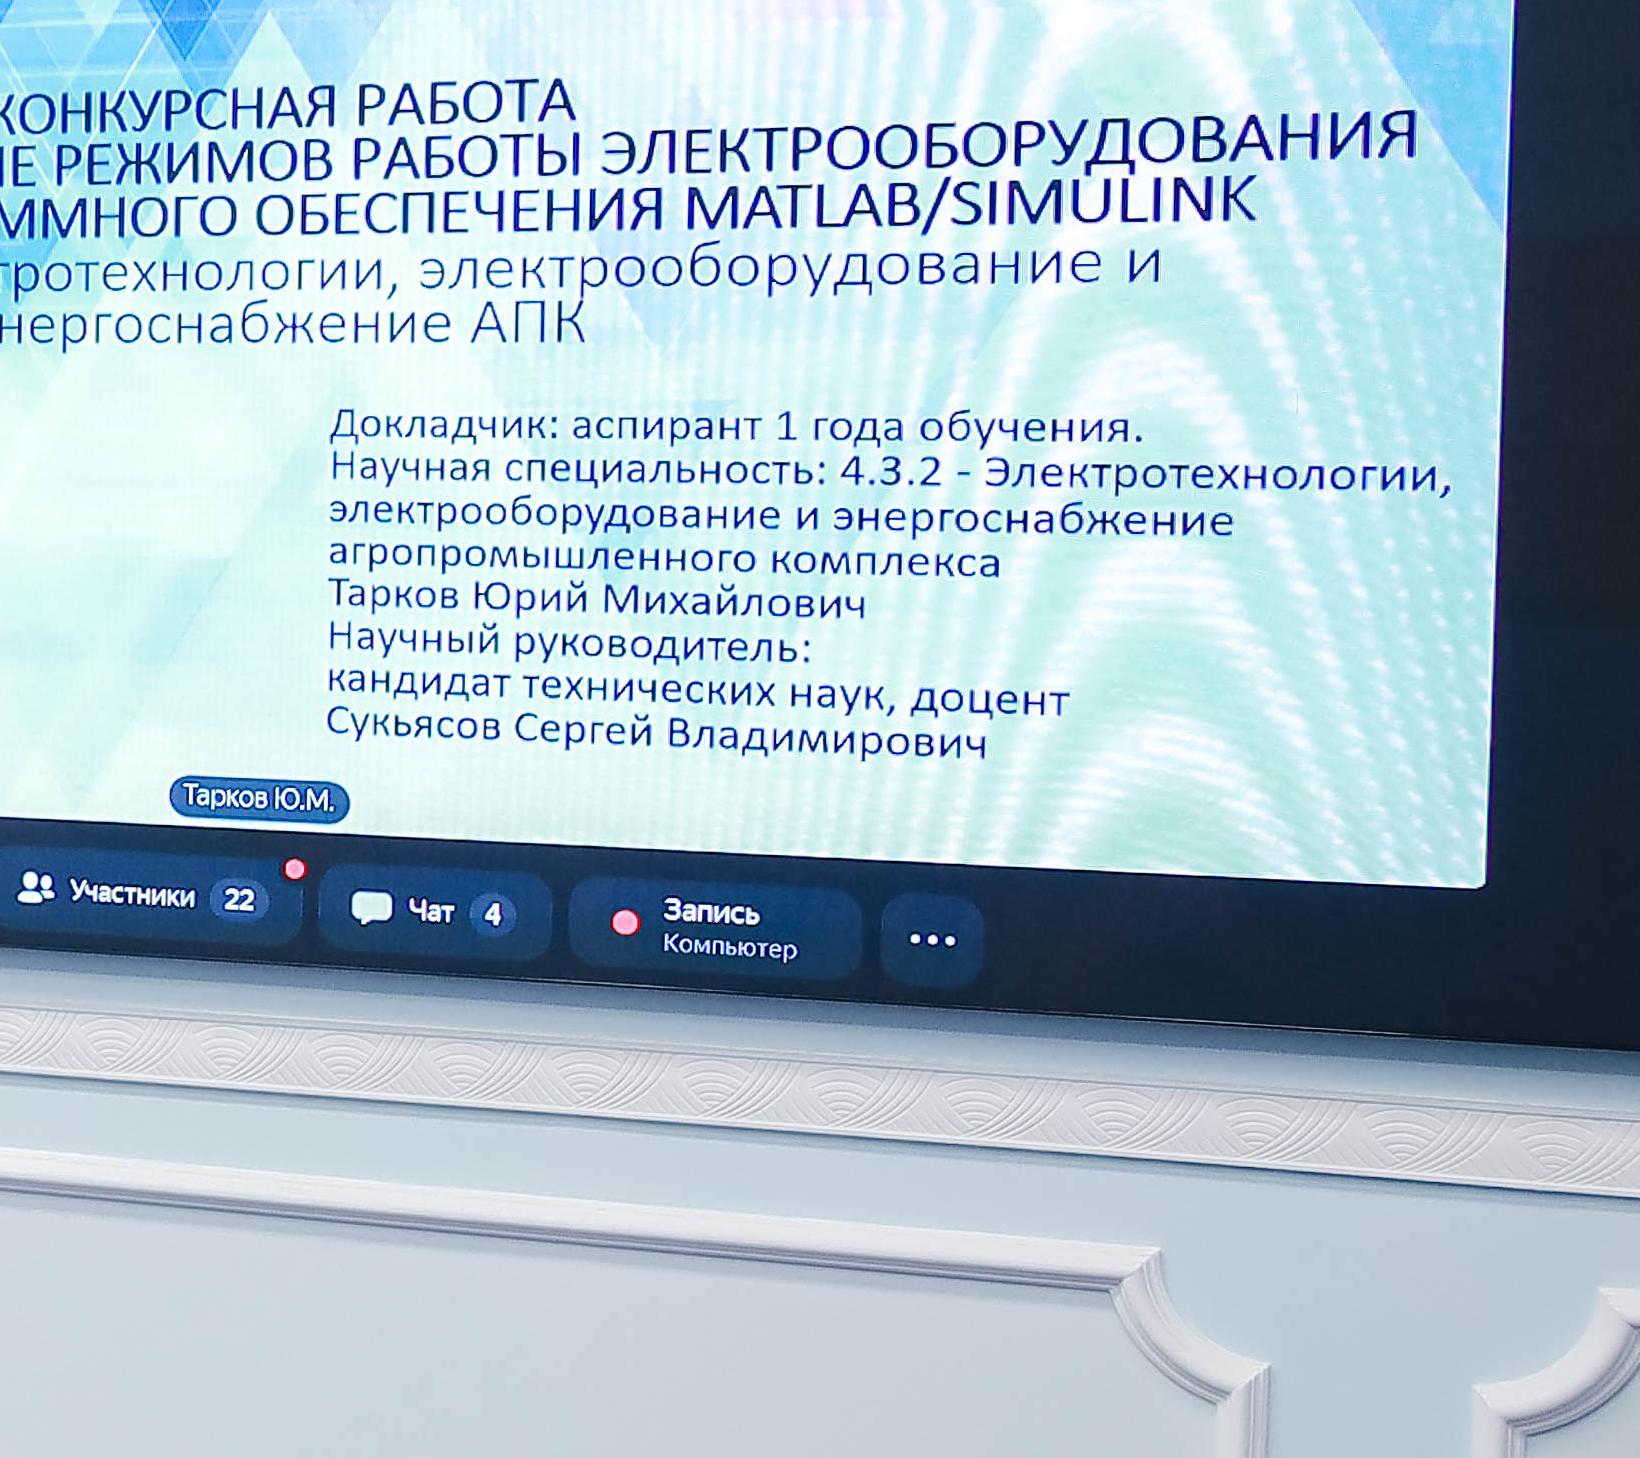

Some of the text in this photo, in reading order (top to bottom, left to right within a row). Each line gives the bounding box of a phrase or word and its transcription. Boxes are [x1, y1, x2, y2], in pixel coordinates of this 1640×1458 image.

[359, 78, 577, 126] РАБОТА
[56, 140, 333, 186] РЕЖИМОВ
[354, 133, 579, 180] РАБОТЫ
[602, 110, 1416, 175] ЭЛЕКТРООБОРУДОВАНИЯ
[256, 187, 663, 235] ОБЕСПЕЧЕНИЯ
[687, 175, 1257, 234] MATLAB/SIMULINK
[419, 241, 1101, 298] электрооборудование
[1128, 248, 1160, 283] и
[471, 300, 584, 343] АПК
[329, 408, 1144, 449] Докладчик: аспирант 1 года обучения.
[332, 451, 490, 486] Научная
[505, 456, 826, 488] специальность:
[840, 456, 941, 486] 4.3.2
[986, 457, 1452, 498] Электротехнологии,
[329, 495, 1233, 539] электрооборудование и энергоснабжение
[329, 543, 1000, 578] агропромышленного комплекса
[328, 578, 865, 619] Тарков Юрий Михайлович
[329, 621, 810, 664] Научный руководитель:
[328, 668, 1070, 718] кандидат технических наук, доцент
[326, 706, 986, 761] Сукьясов Сергей Владимирович
[183, 784, 335, 817] Тарков Ю.М.
[69, 877, 255, 913] Участники 22
[409, 898, 502, 926] Чат 4
[663, 898, 760, 927] Запись
[663, 933, 798, 963] Компьютер
